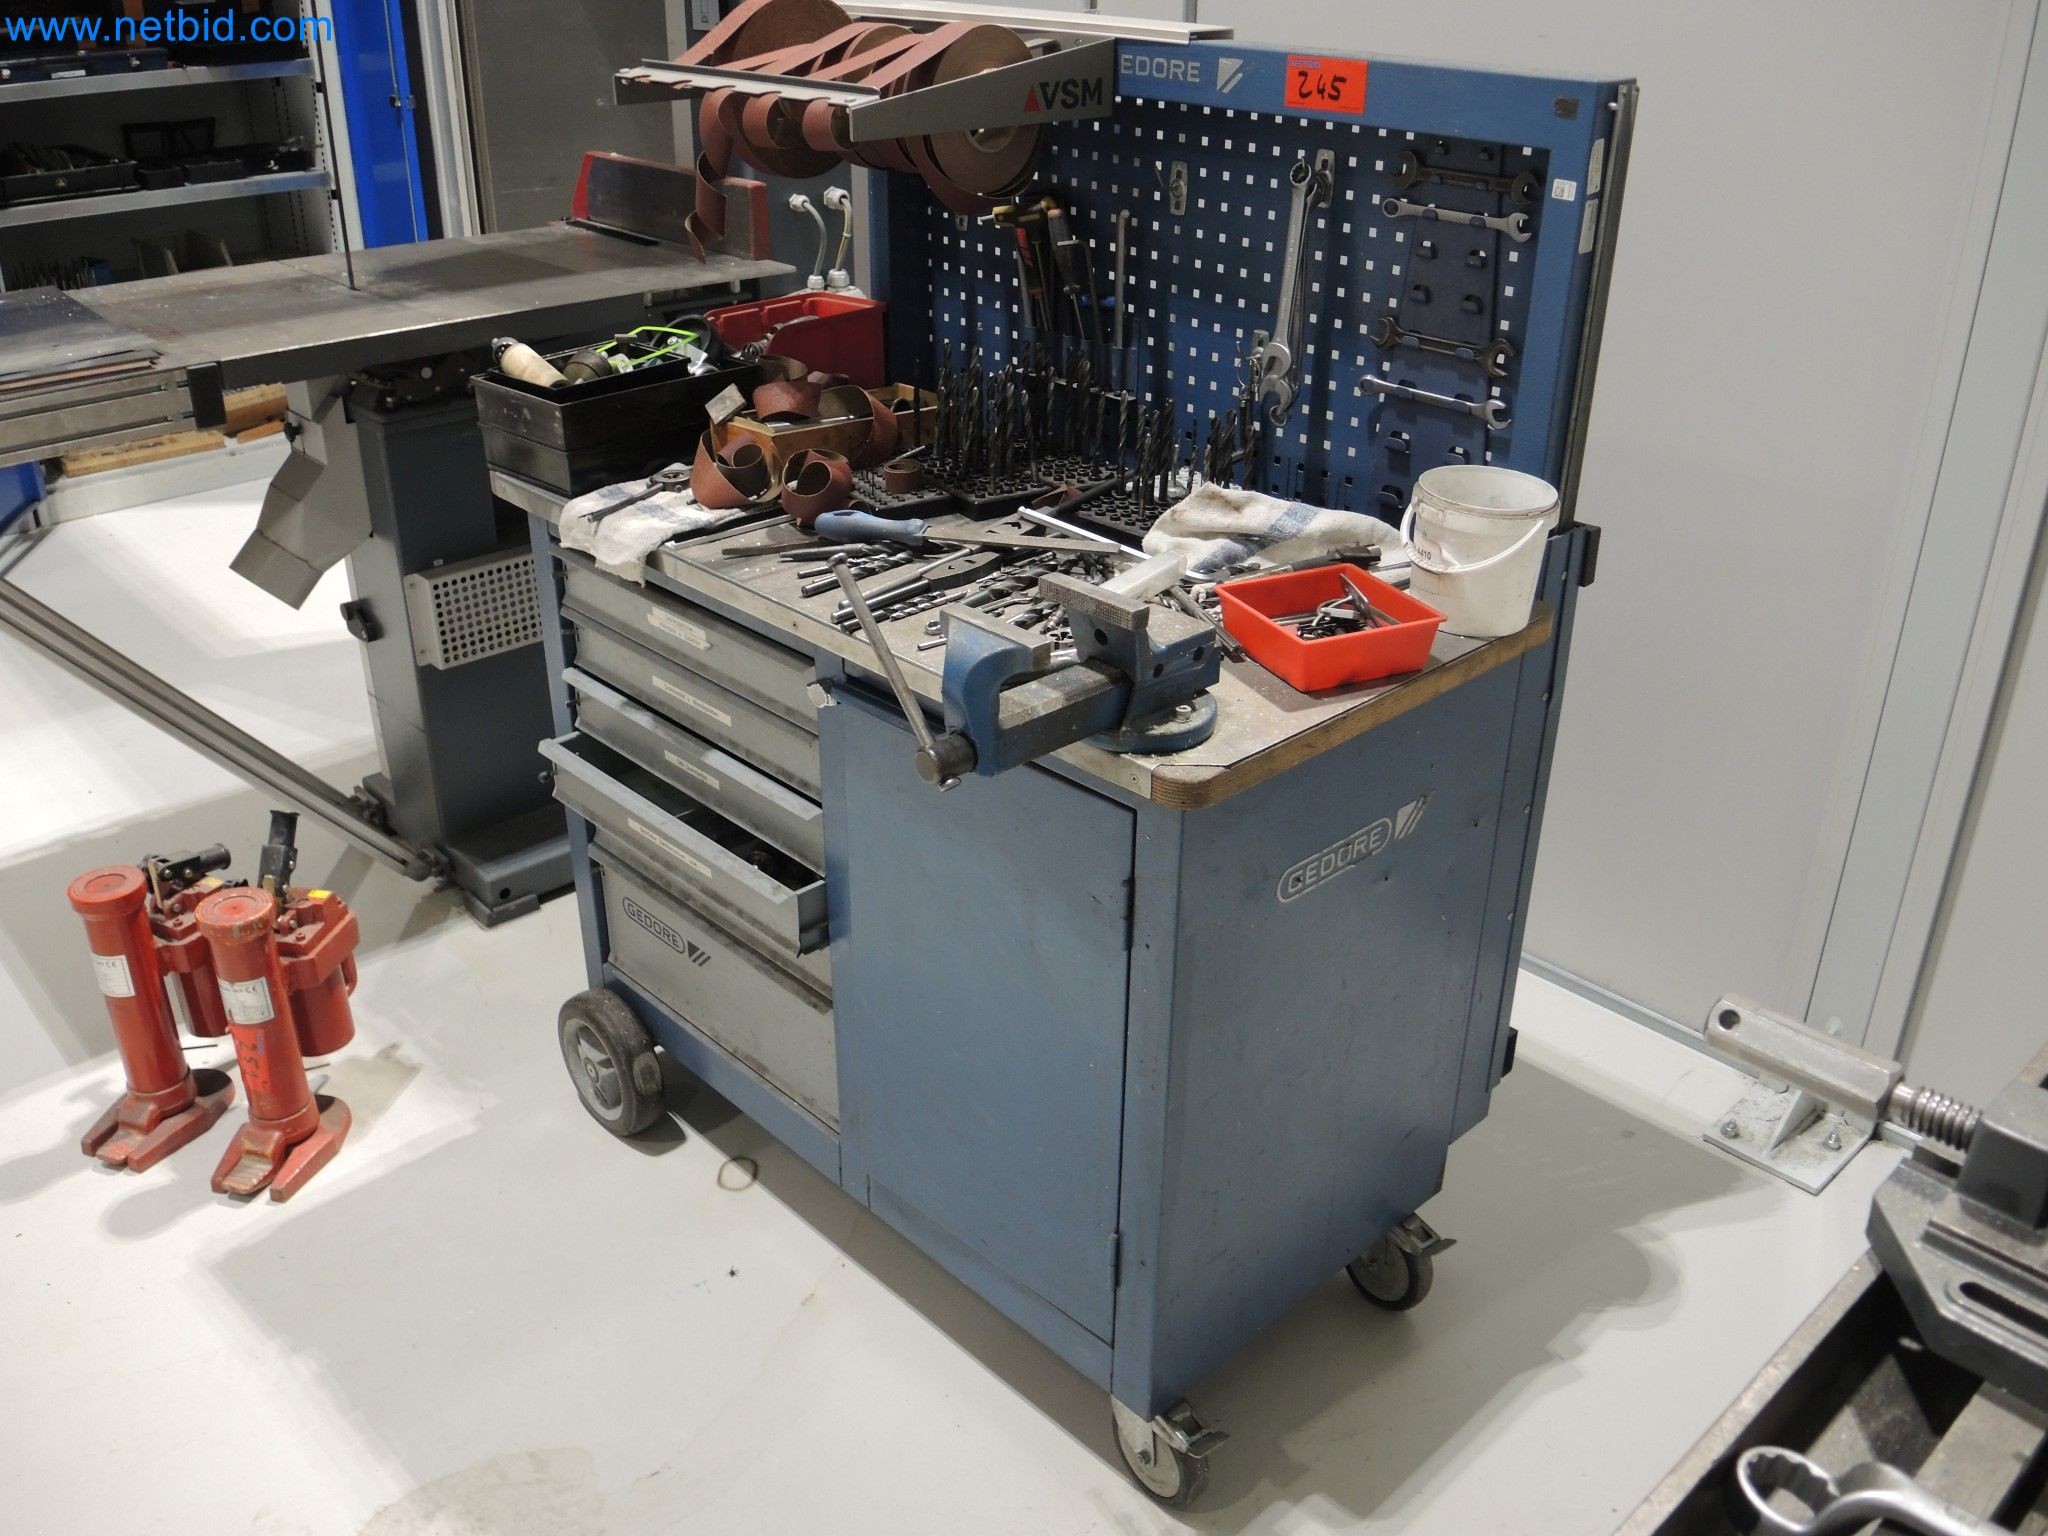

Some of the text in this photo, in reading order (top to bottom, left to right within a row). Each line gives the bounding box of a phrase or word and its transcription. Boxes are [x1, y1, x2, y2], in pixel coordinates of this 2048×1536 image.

[1120, 54, 1200, 82] EDORE
[1039, 77, 1103, 111] VSM
[1298, 70, 1347, 101] 245
[1288, 827, 1382, 893] GEDORE
[627, 902, 681, 949] GEDORE
